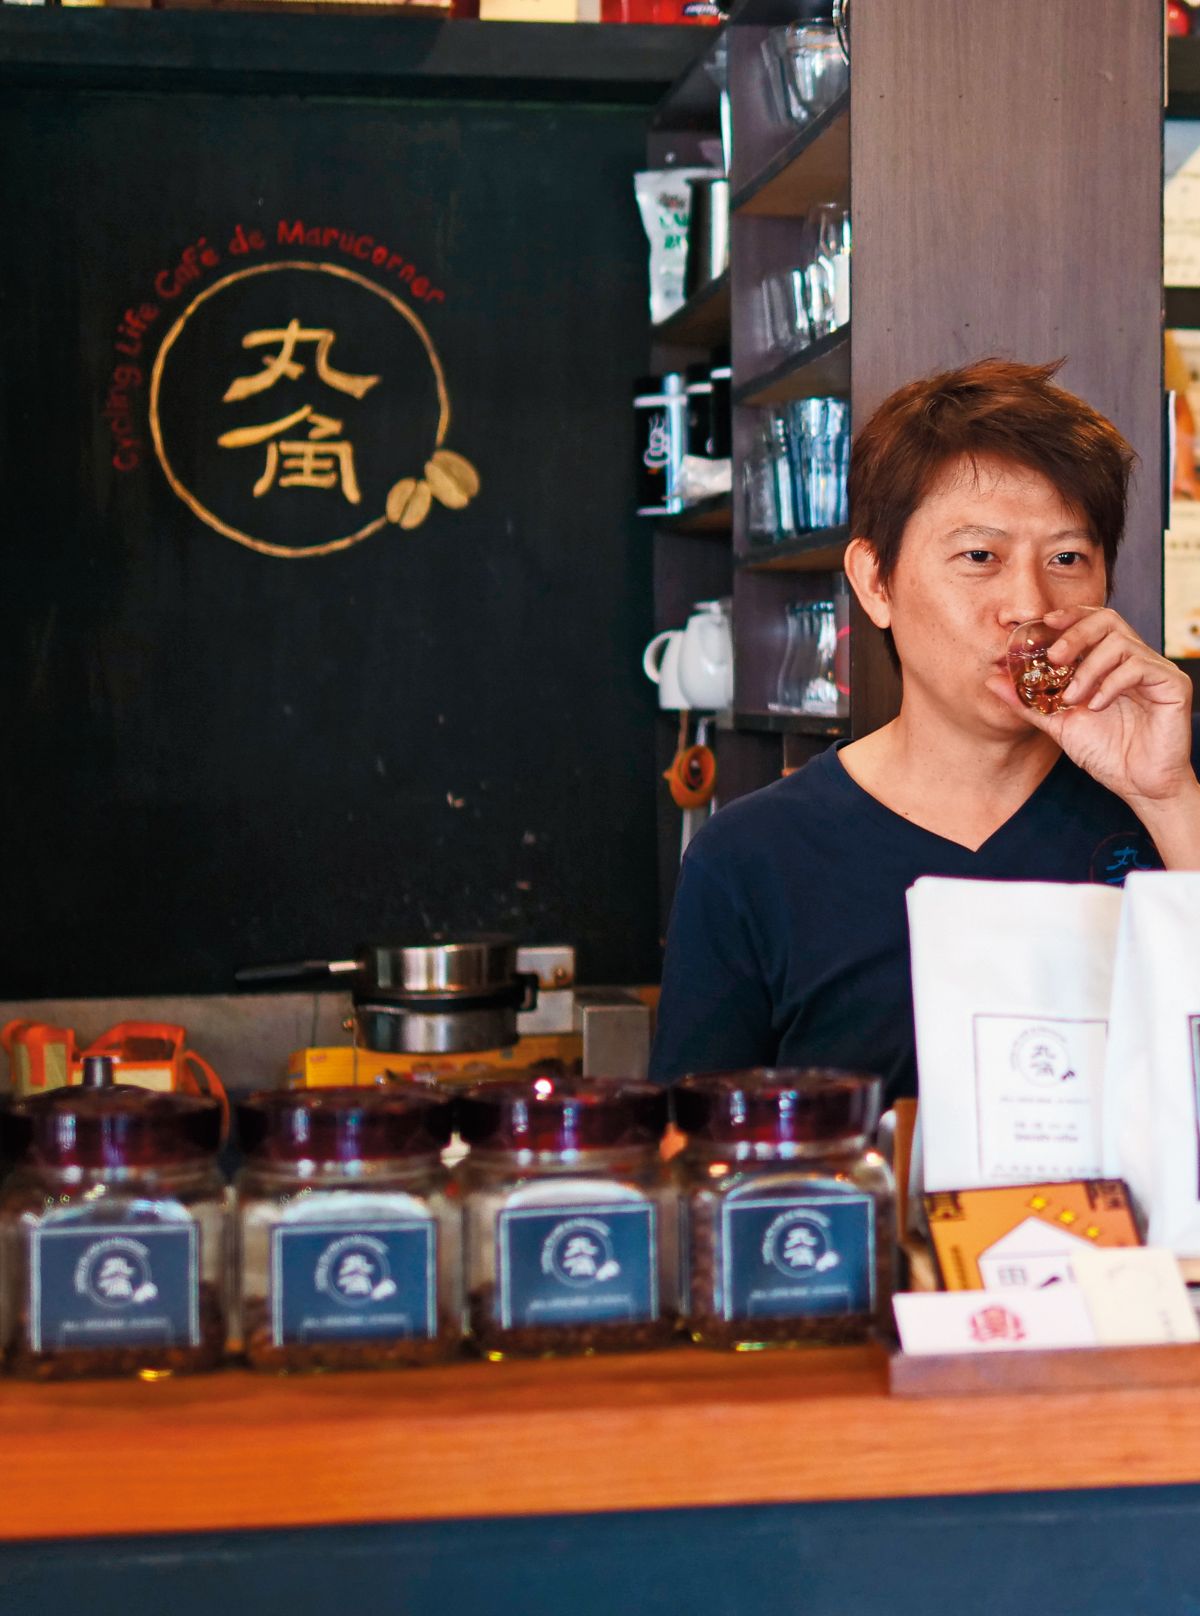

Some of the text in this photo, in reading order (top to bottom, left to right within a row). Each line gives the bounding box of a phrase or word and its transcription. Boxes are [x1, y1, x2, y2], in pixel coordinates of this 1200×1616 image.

[114, 303, 159, 357] Life
[154, 235, 220, 299] Café
[229, 223, 266, 255] de
